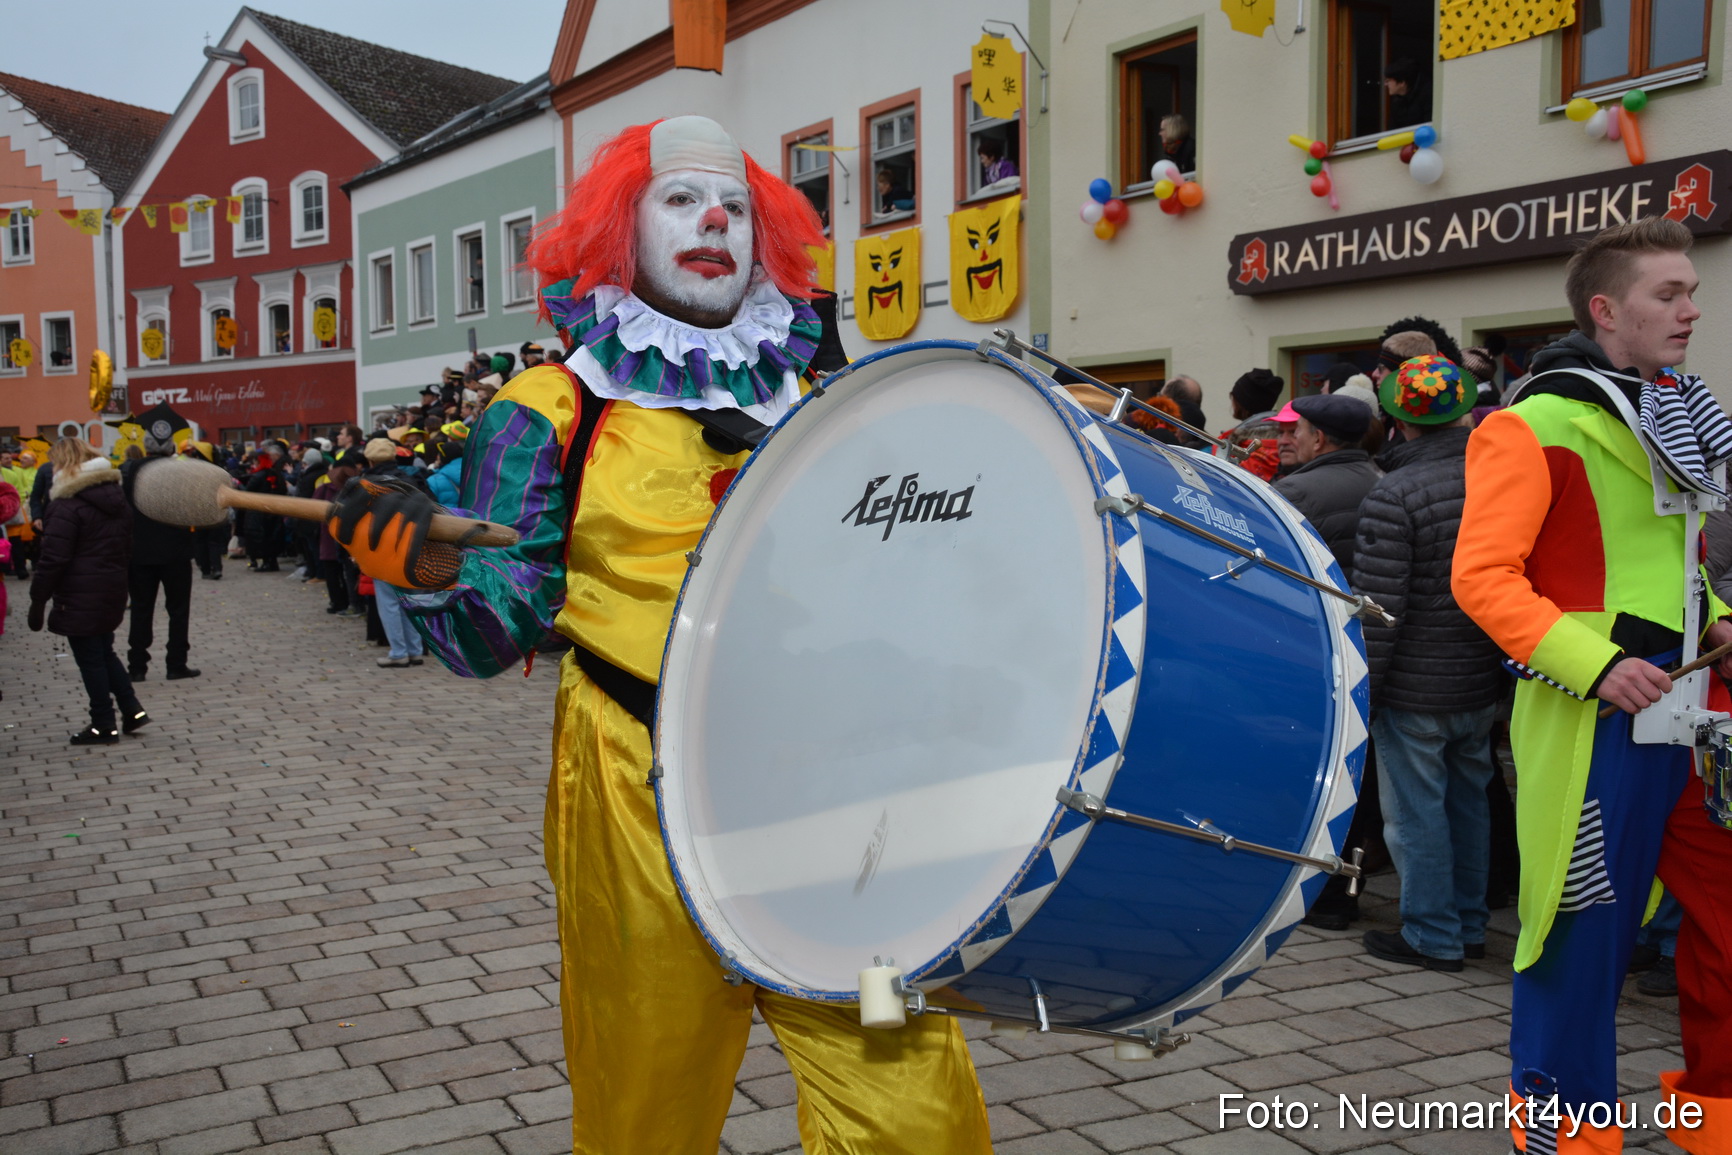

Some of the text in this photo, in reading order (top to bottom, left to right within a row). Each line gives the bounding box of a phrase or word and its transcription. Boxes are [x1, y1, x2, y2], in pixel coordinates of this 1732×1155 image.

[1273, 179, 1654, 277] RATHAUS APOTHEKE
[1213, 522, 1256, 546] PERCUSSION
